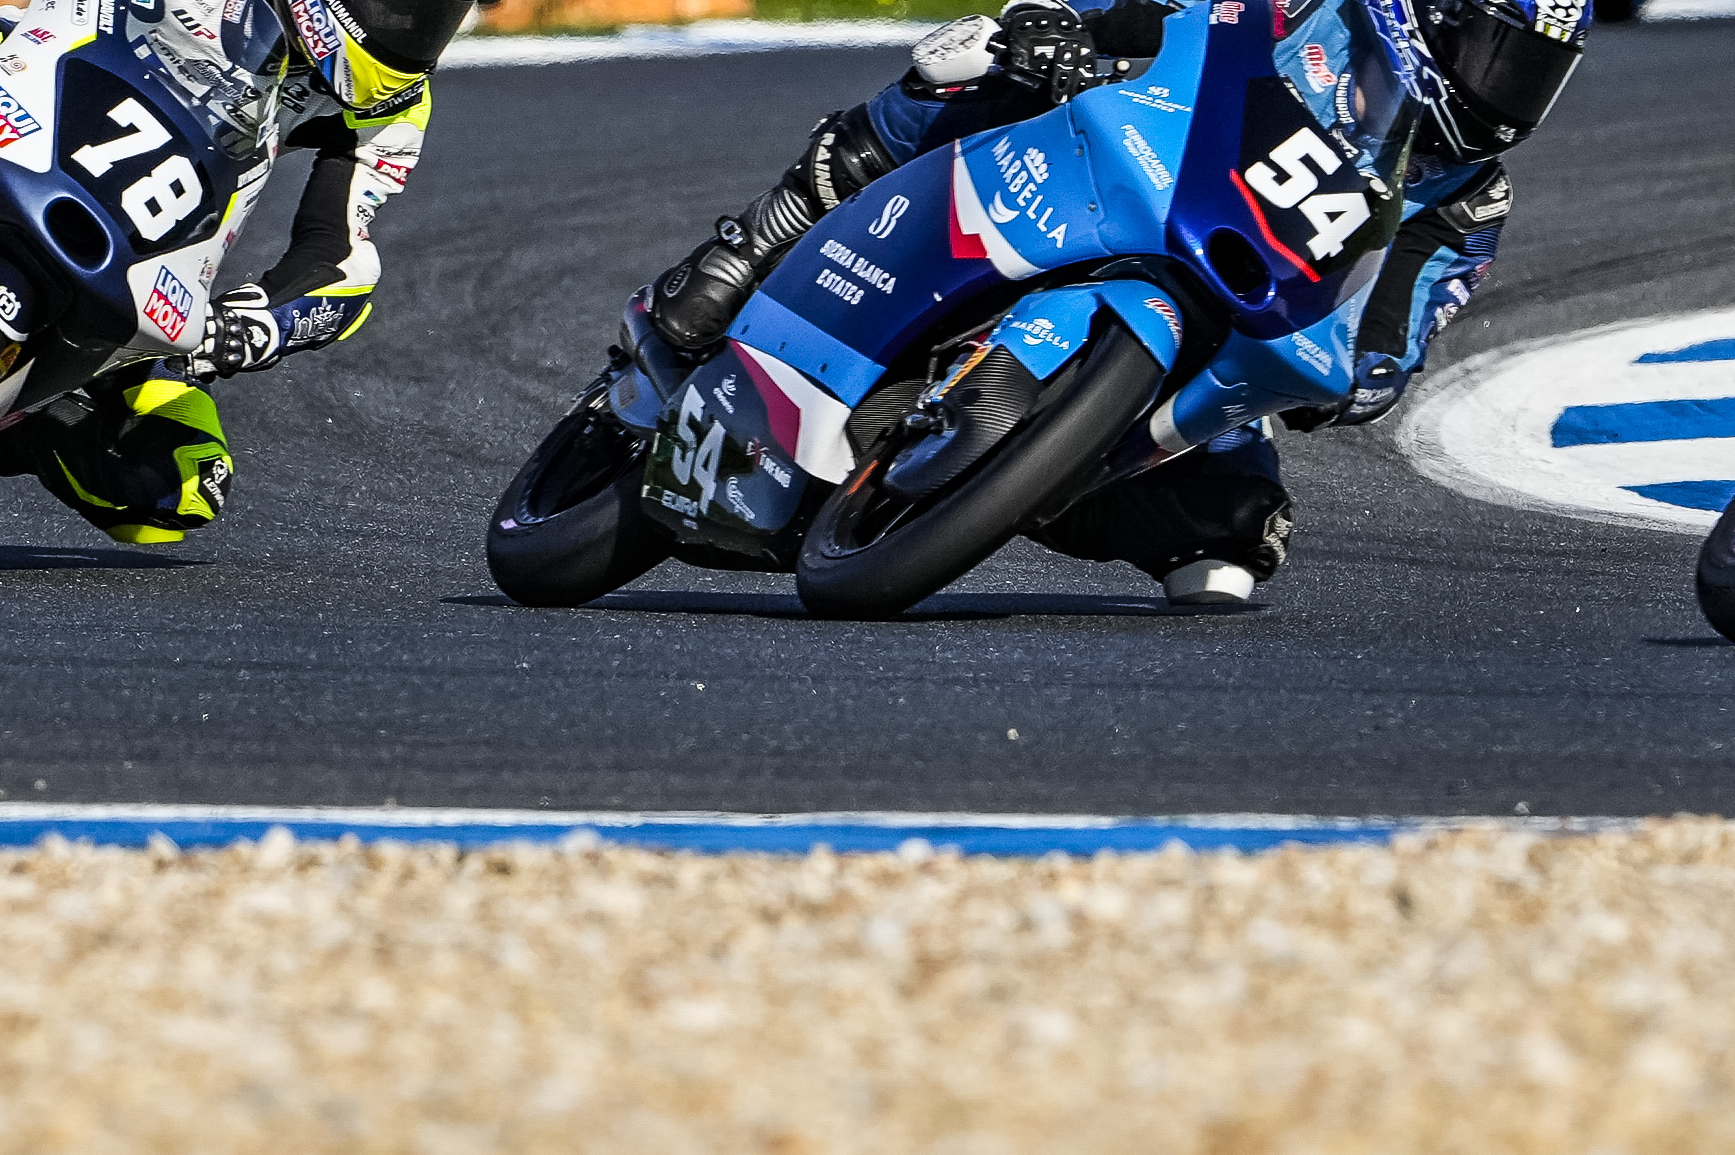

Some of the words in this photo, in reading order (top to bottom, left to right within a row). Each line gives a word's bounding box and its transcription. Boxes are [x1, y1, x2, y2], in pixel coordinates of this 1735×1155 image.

[292, 1, 329, 59] MOLY
[71, 97, 203, 241] 78
[991, 135, 1069, 249] MARBELLA
[1243, 126, 1372, 260] 54
[156, 270, 191, 318] LIQUI
[816, 269, 865, 305] ESTATES
[819, 239, 858, 269] SIERRA
[853, 256, 897, 295] BLANCA
[145, 293, 185, 339] MOLY
[1008, 321, 1070, 351] MARBELLA
[671, 383, 727, 517] 54
